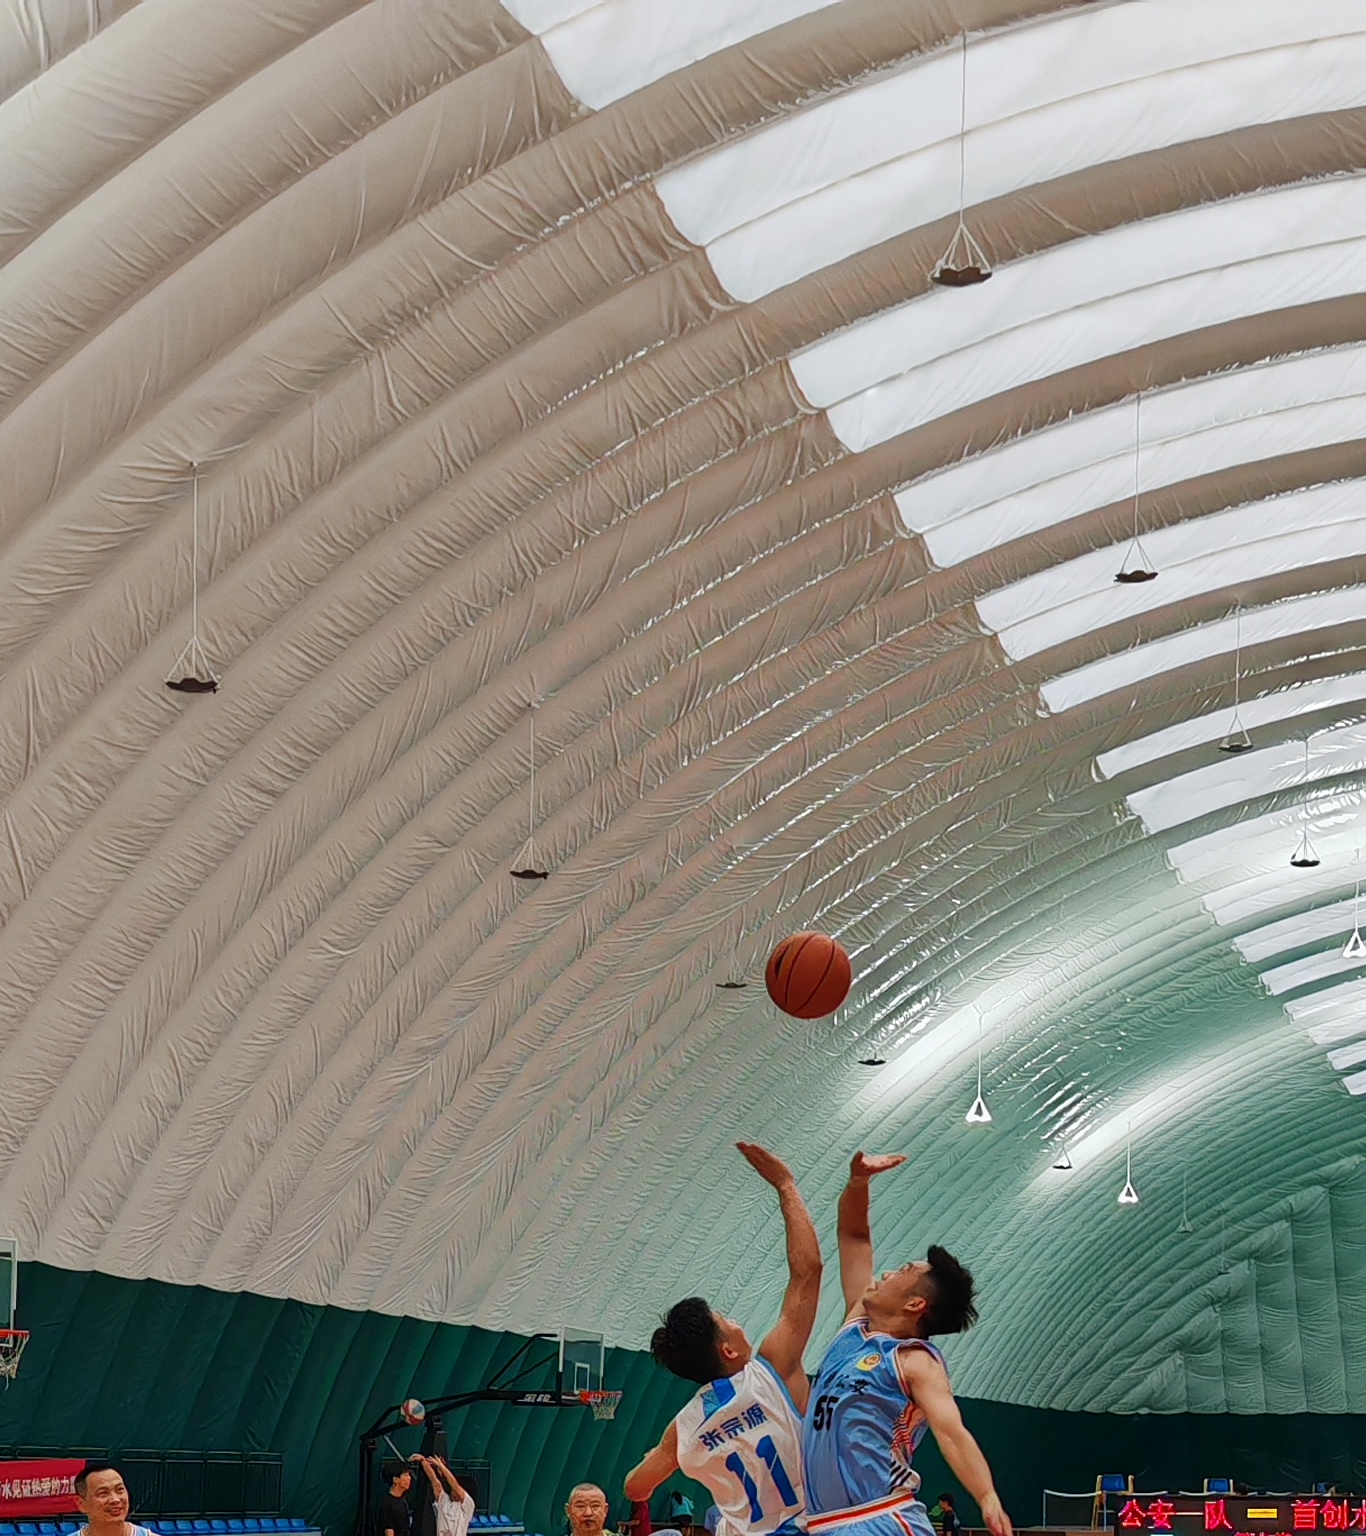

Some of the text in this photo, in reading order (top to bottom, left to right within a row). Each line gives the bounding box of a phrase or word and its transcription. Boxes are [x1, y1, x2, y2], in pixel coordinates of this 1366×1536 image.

[698, 1402, 768, 1452] 张宗源
[725, 1434, 799, 1524] 11
[1118, 1499, 1234, 1530] 公安一队
